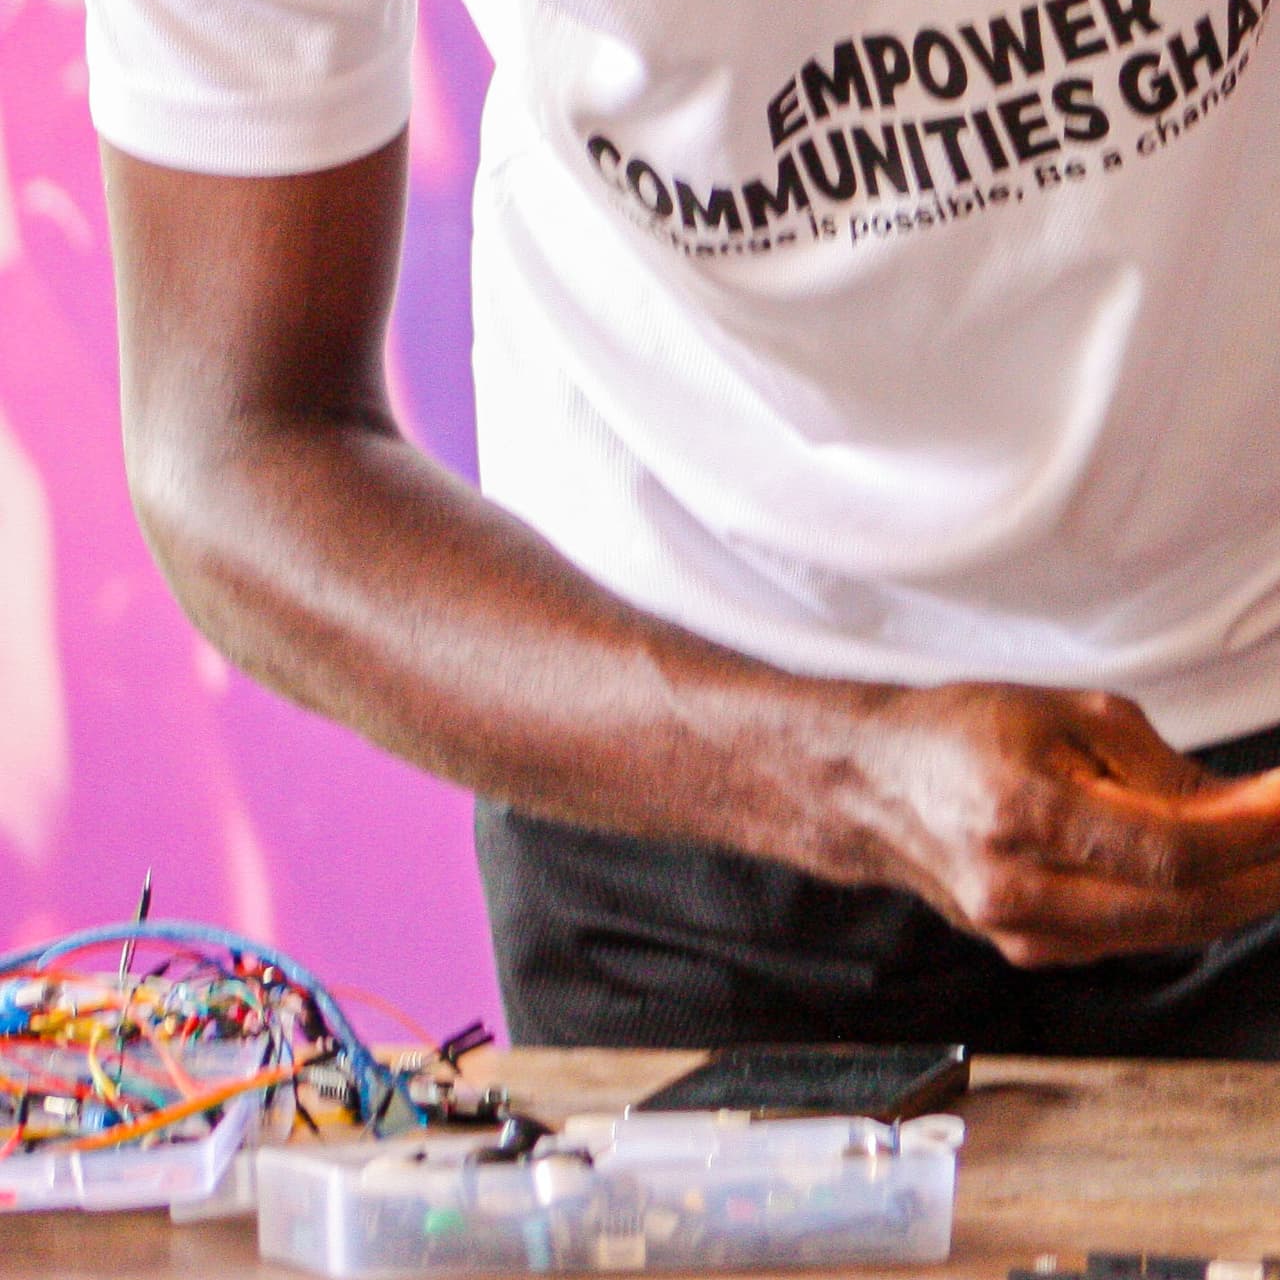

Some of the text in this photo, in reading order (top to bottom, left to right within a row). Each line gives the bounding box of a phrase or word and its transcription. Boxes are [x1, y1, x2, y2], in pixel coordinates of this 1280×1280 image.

[587, 77, 1110, 232] COMMUNITIES
[1035, 164, 1087, 197] Be
[1103, 150, 1123, 171] a
